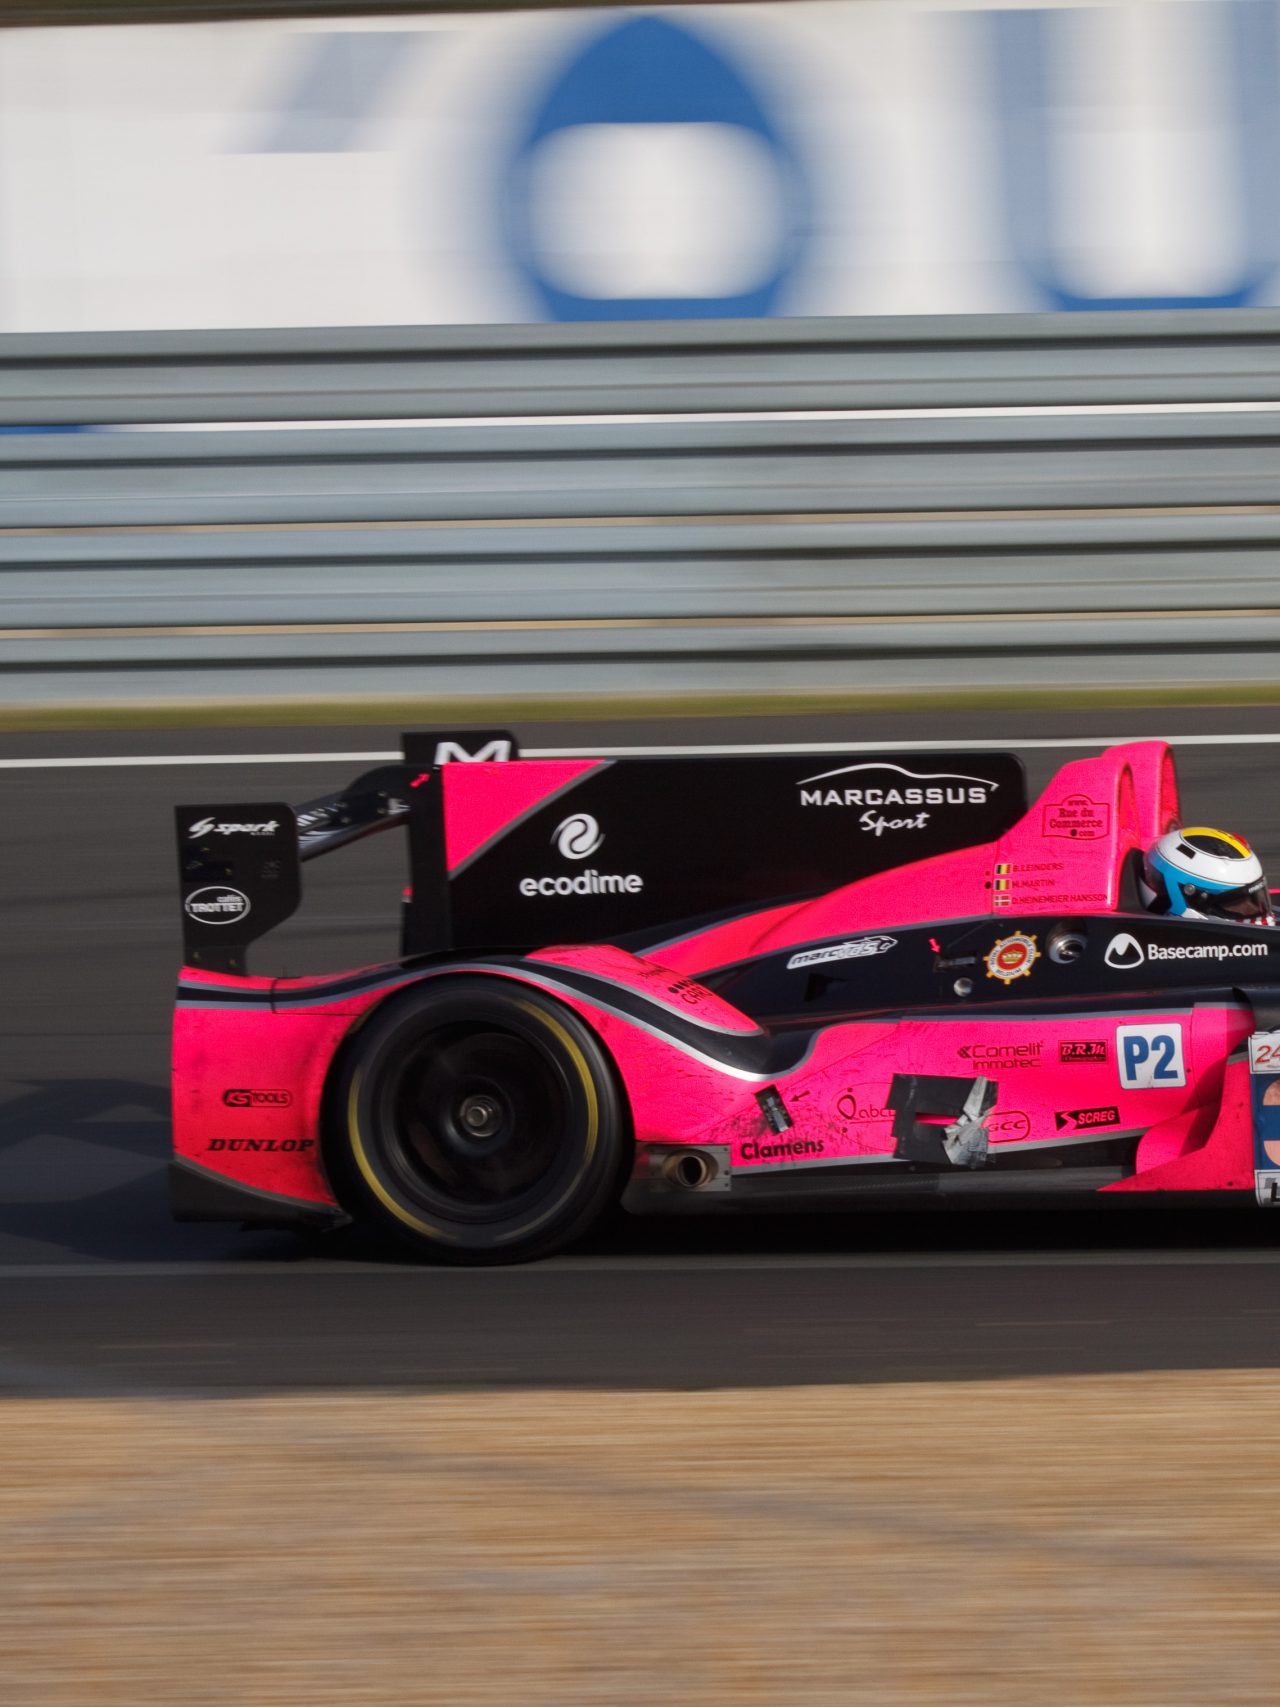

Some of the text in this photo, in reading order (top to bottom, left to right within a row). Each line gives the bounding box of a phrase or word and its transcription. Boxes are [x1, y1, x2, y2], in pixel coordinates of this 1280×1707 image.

[800, 788, 987, 806] MARCASSUS
[1058, 808, 1094, 818] Rue du
[859, 809, 931, 837] Sport
[1049, 818, 1103, 828] Commerce
[519, 869, 644, 897] ecodime
[1147, 943, 1268, 961] Basecamp.com
[972, 1043, 1043, 1059] Comelit
[1123, 1035, 1179, 1081] P2
[1078, 1111, 1116, 1124] SCREG
[206, 1138, 315, 1152] DUNLOP
[740, 1140, 824, 1160] Clamens
